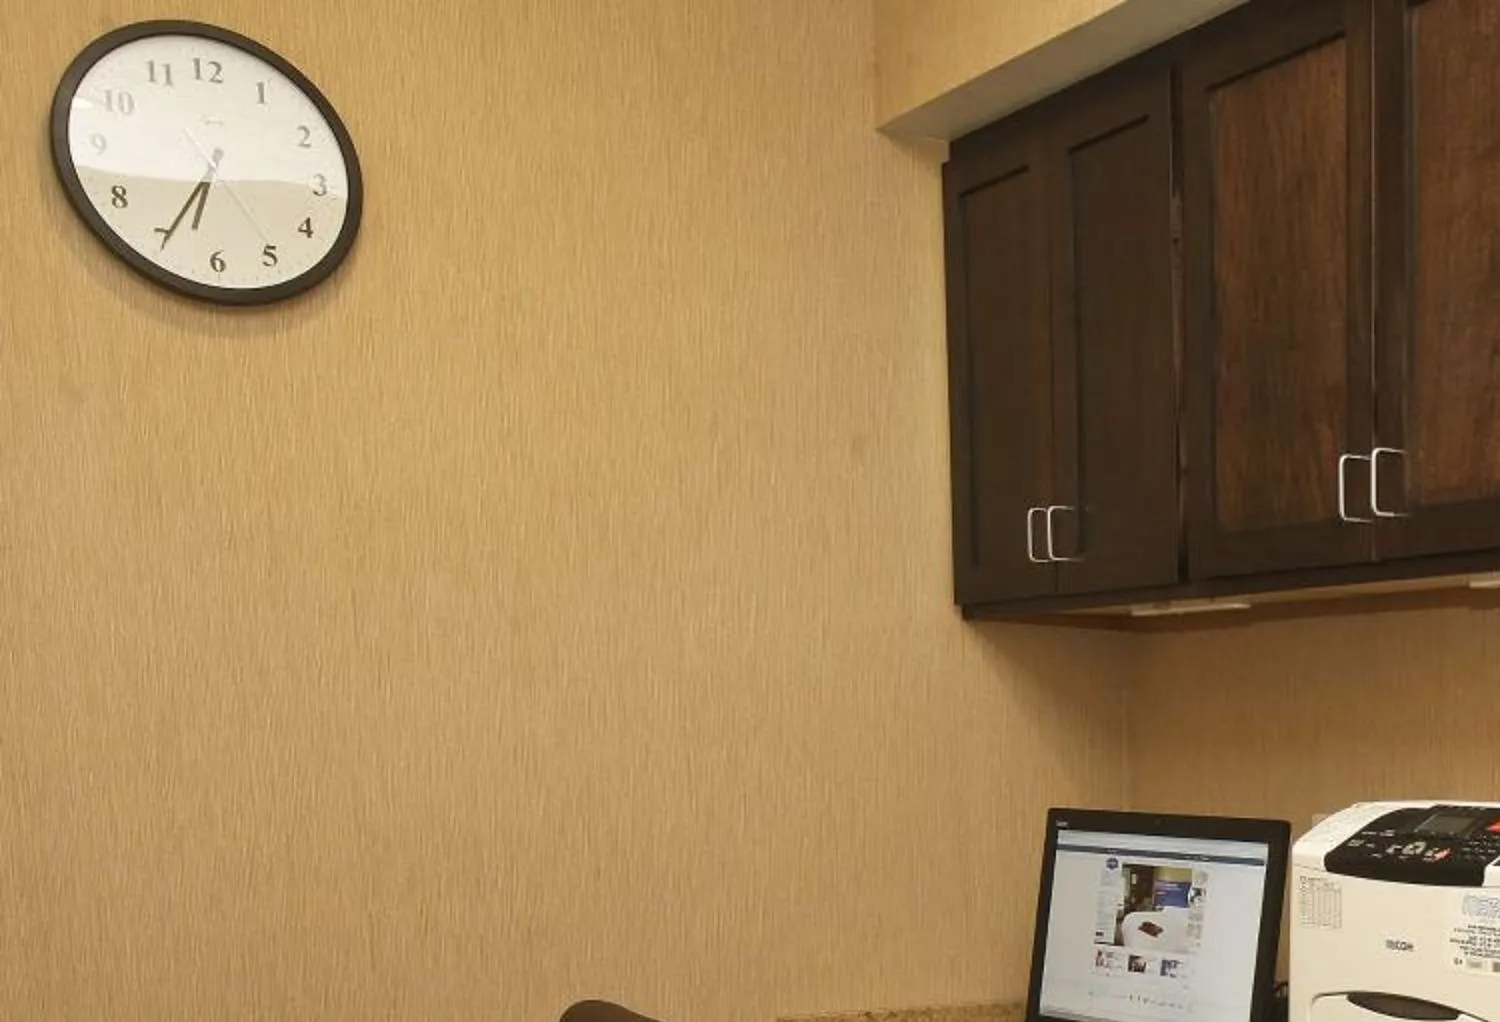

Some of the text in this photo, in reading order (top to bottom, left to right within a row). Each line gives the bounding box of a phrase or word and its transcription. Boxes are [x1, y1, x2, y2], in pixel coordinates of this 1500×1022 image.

[146, 60, 174, 87] 11
[193, 57, 223, 84] 12
[103, 89, 135, 116] 10
[256, 81, 267, 105] 1
[90, 133, 107, 156] 9
[296, 125, 312, 149] 2
[111, 185, 129, 209] 8
[312, 173, 328, 198] 3
[297, 216, 314, 239] 4
[209, 250, 226, 273] 6
[262, 244, 279, 268] 5
